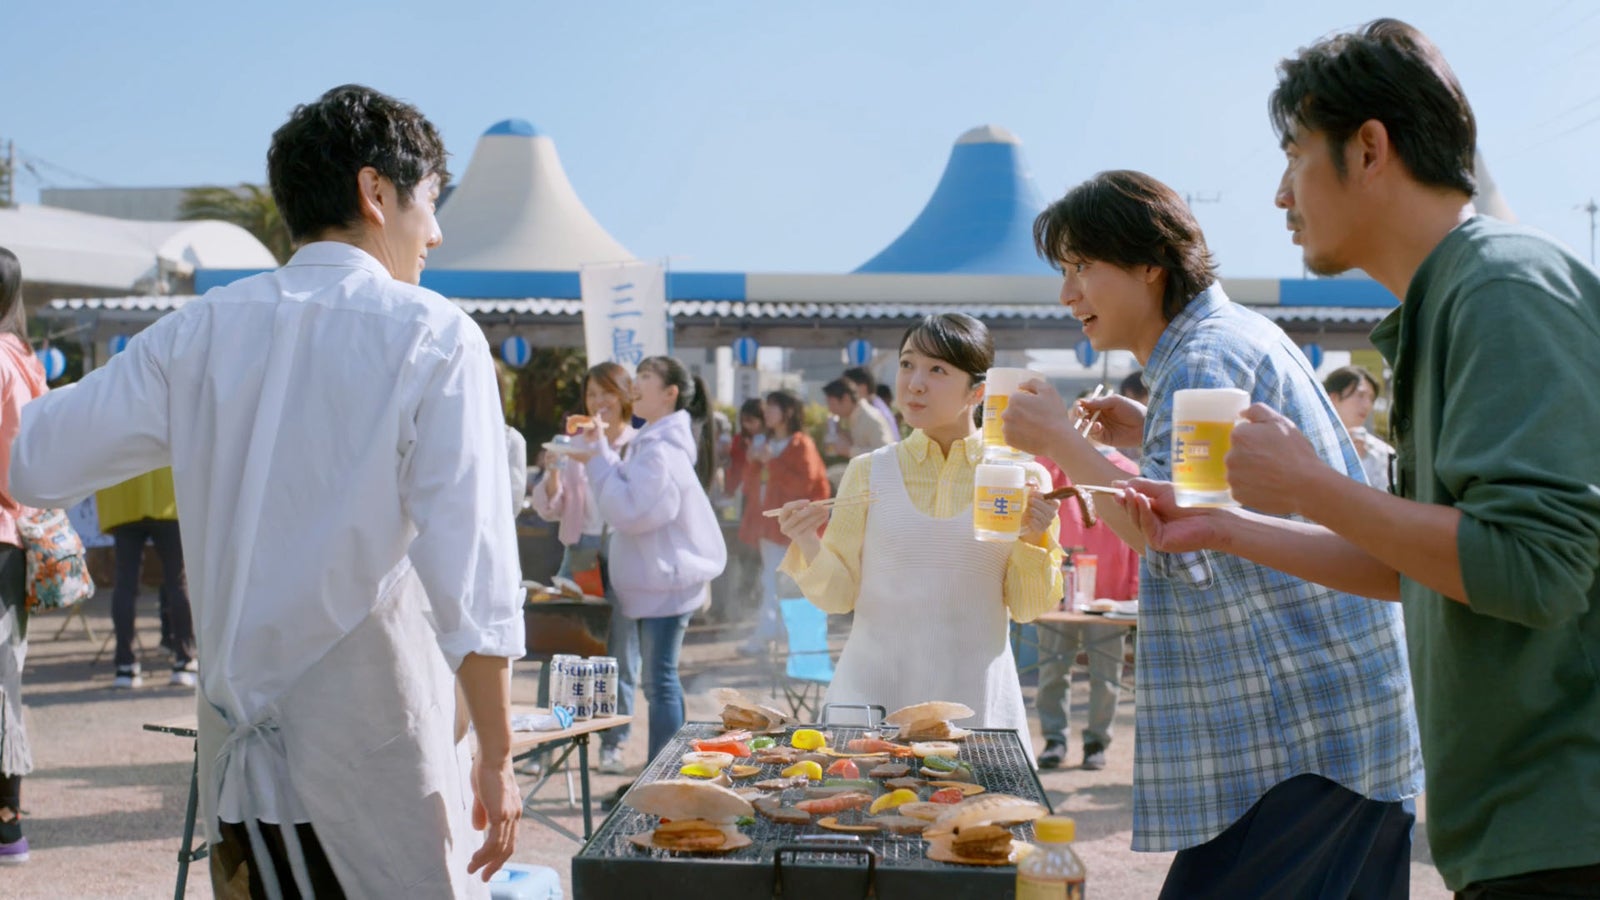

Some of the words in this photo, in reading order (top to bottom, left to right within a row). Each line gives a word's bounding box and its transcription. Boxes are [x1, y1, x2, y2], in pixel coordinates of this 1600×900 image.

[994, 497, 1008, 514] 生
[572, 682, 584, 696] 生
[594, 680, 606, 693] 生
